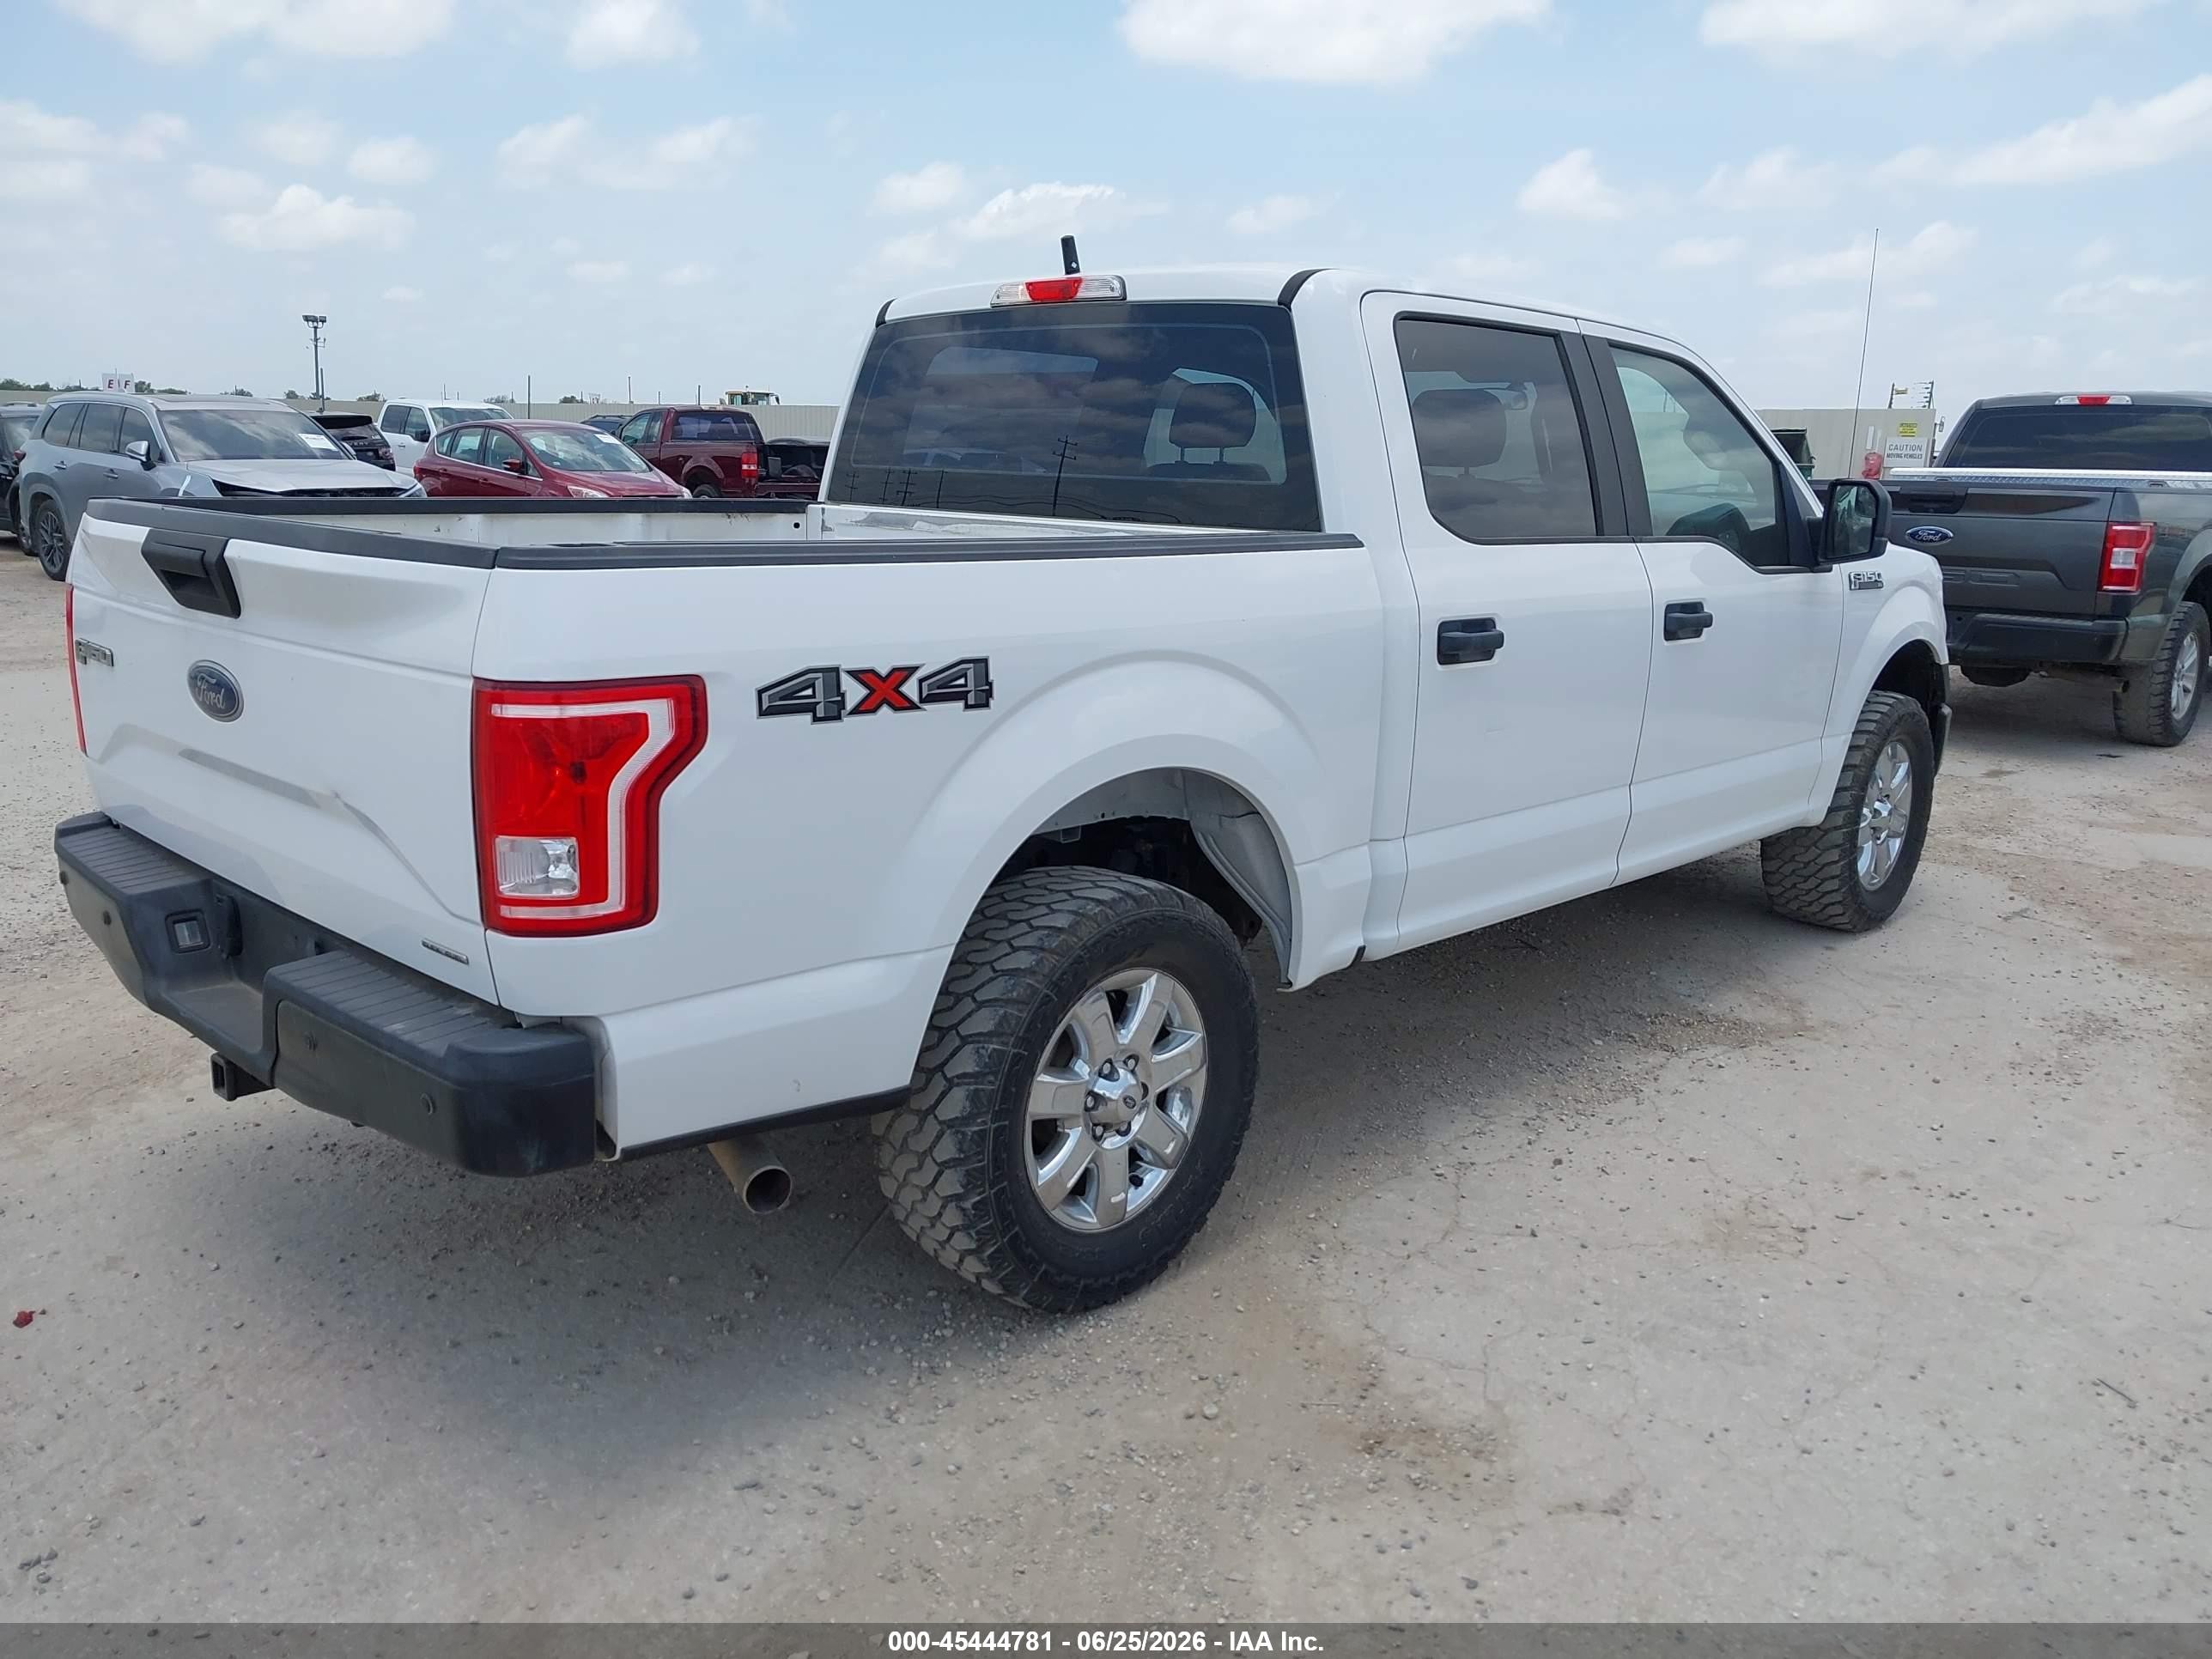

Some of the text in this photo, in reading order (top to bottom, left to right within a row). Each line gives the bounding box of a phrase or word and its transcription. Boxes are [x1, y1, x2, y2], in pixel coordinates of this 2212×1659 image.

[107, 379, 114, 389] E
[124, 380, 131, 389] F
[1888, 443, 1923, 452] CAUTION
[1916, 529, 1942, 541] Ford
[195, 672, 227, 709] Ford
